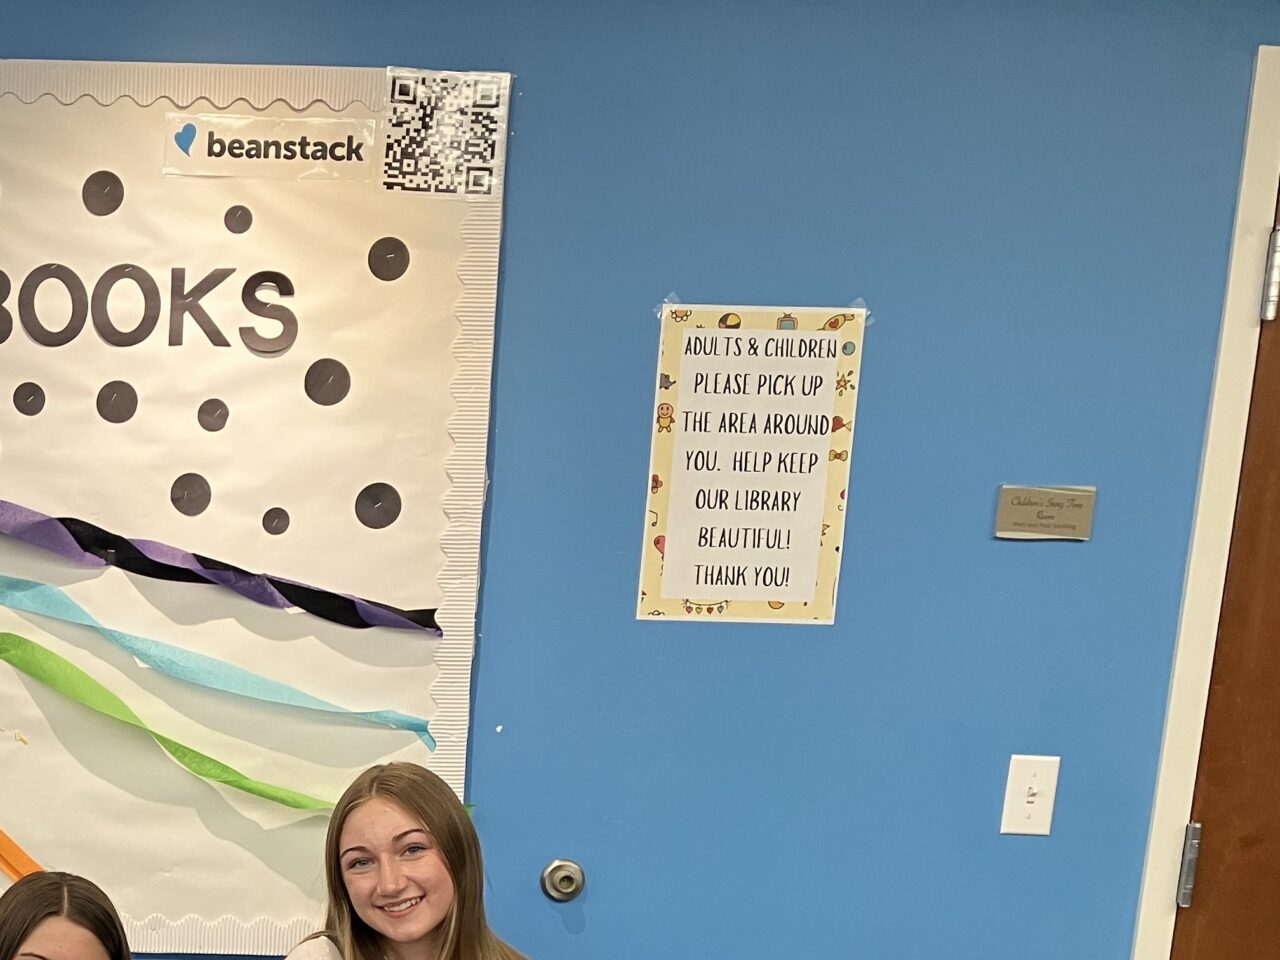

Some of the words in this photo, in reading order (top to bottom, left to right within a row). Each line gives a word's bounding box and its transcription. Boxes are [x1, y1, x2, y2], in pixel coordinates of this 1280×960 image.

[206, 131, 364, 161] beanstack
[684, 336, 742, 357] ADULTS
[748, 337, 759, 357] &
[764, 337, 837, 359] CHILDREN
[693, 372, 751, 395] PLEASE
[756, 374, 796, 396] PICK
[801, 375, 824, 397] UP
[682, 410, 712, 433] THE
[718, 412, 757, 434] AREA
[763, 413, 830, 436] AROUND
[685, 450, 721, 472] YOU.
[732, 451, 773, 473] HELP
[777, 452, 818, 474] KEEP
[695, 488, 729, 510] OUR
[734, 489, 801, 512] LIBRARY
[698, 526, 791, 550] BEAUTIFUL!
[693, 564, 748, 586] THANK
[754, 566, 790, 587] YOU!
